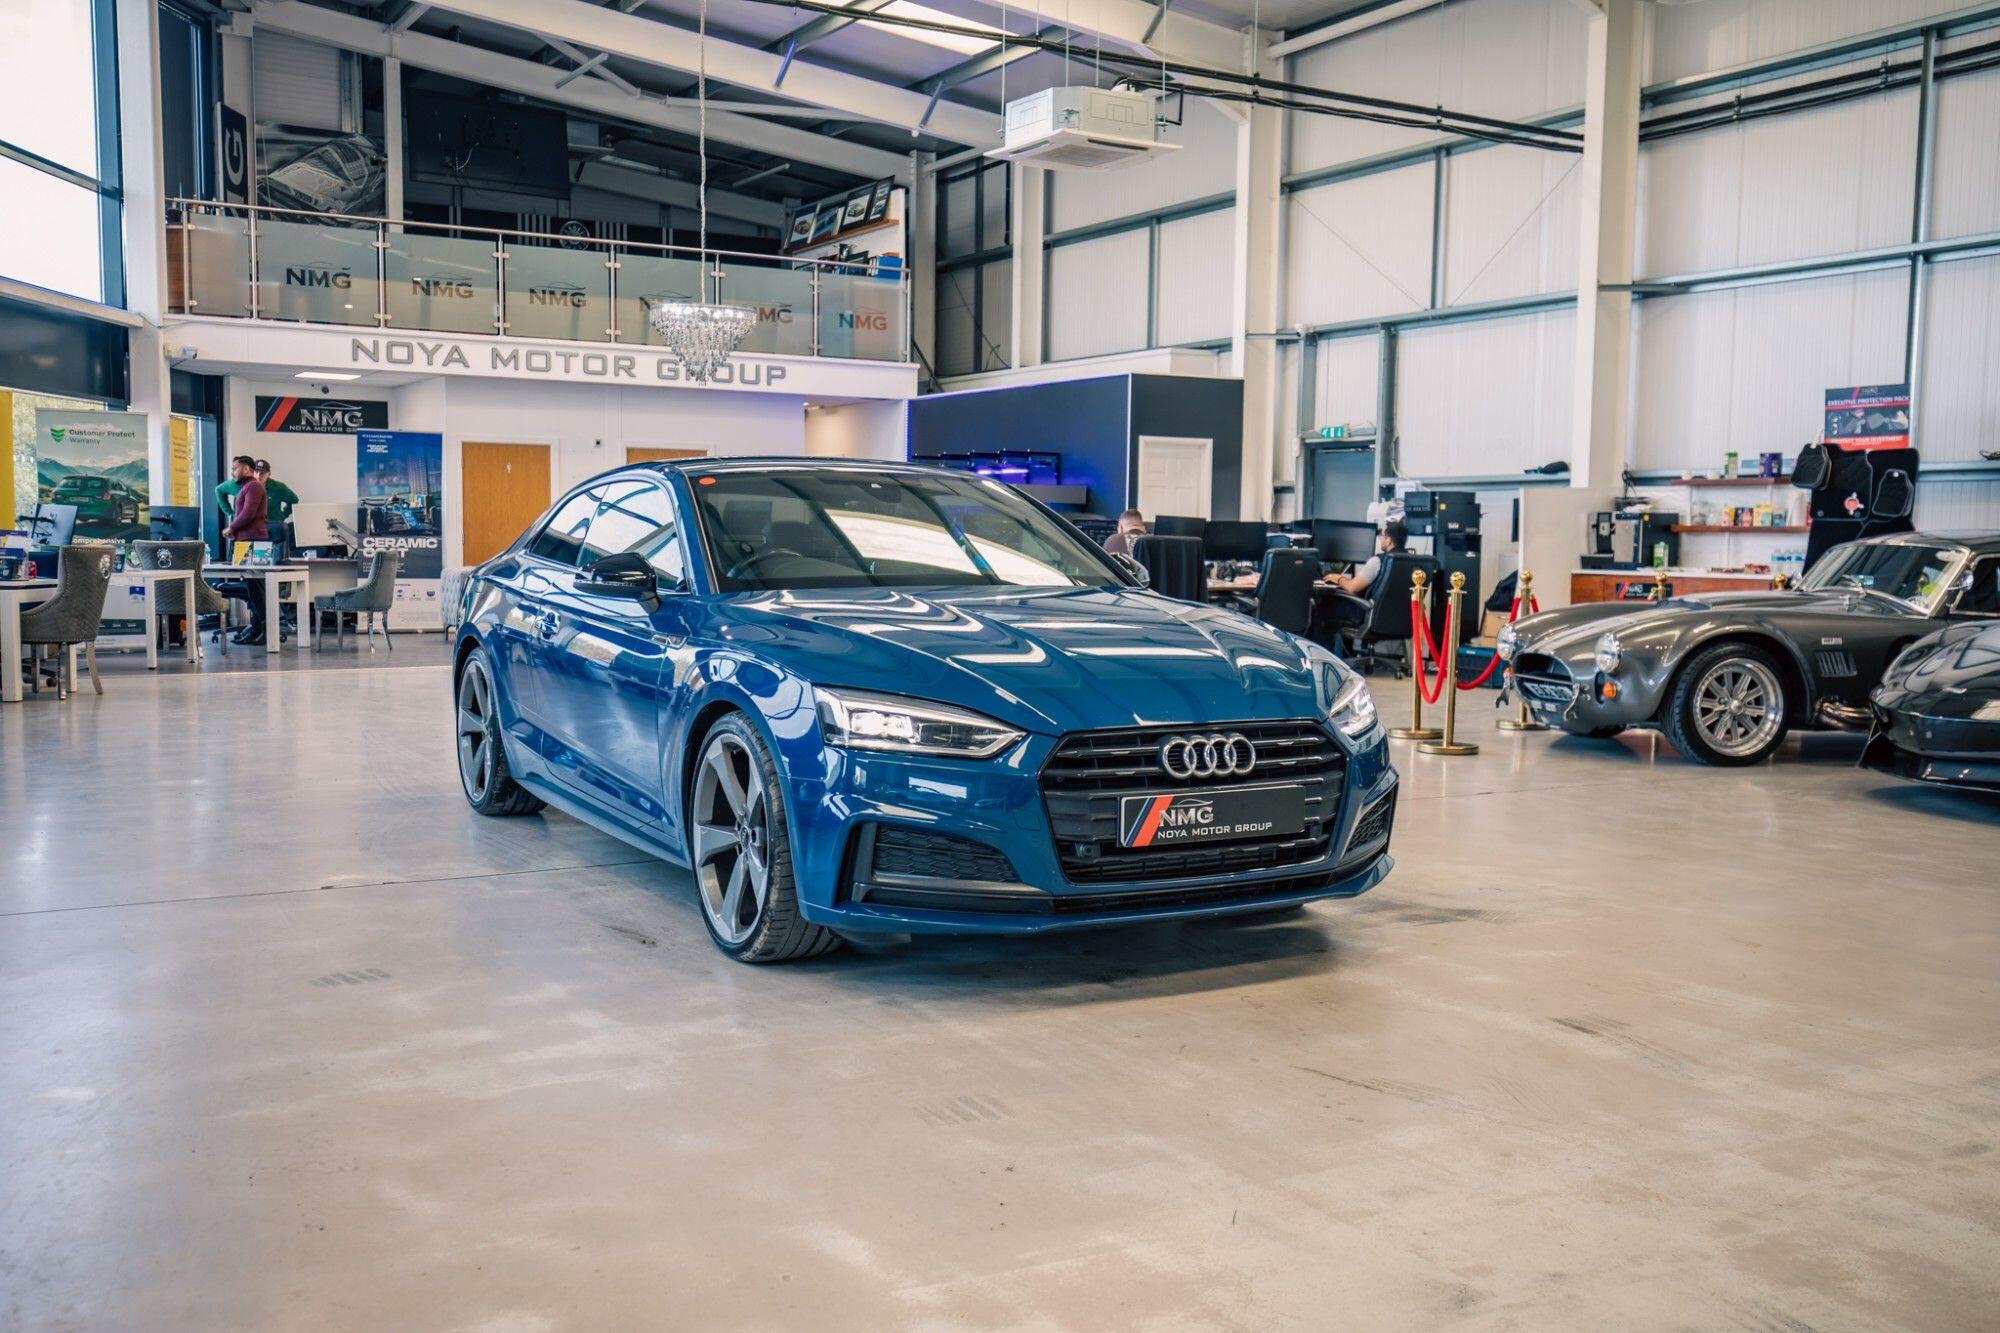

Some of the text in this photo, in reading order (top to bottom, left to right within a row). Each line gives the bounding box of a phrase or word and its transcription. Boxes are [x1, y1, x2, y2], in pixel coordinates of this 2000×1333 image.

[286, 268, 351, 289] NMG
[412, 278, 474, 299] NMG
[529, 288, 587, 308] NMG
[754, 307, 793, 324] MG
[839, 313, 887, 331] NMG
[351, 338, 470, 368] NOYA
[491, 347, 636, 377] MOTOR
[300, 408, 363, 427] NMG
[69, 429, 136, 438] Customer Protect
[72, 537, 126, 546] omprehensive
[362, 537, 438, 549] CERAMIC
[362, 548, 409, 558] CT
[1159, 806, 1214, 827] NMG
[1157, 821, 1273, 839] NOYA MOTOR GROUP
